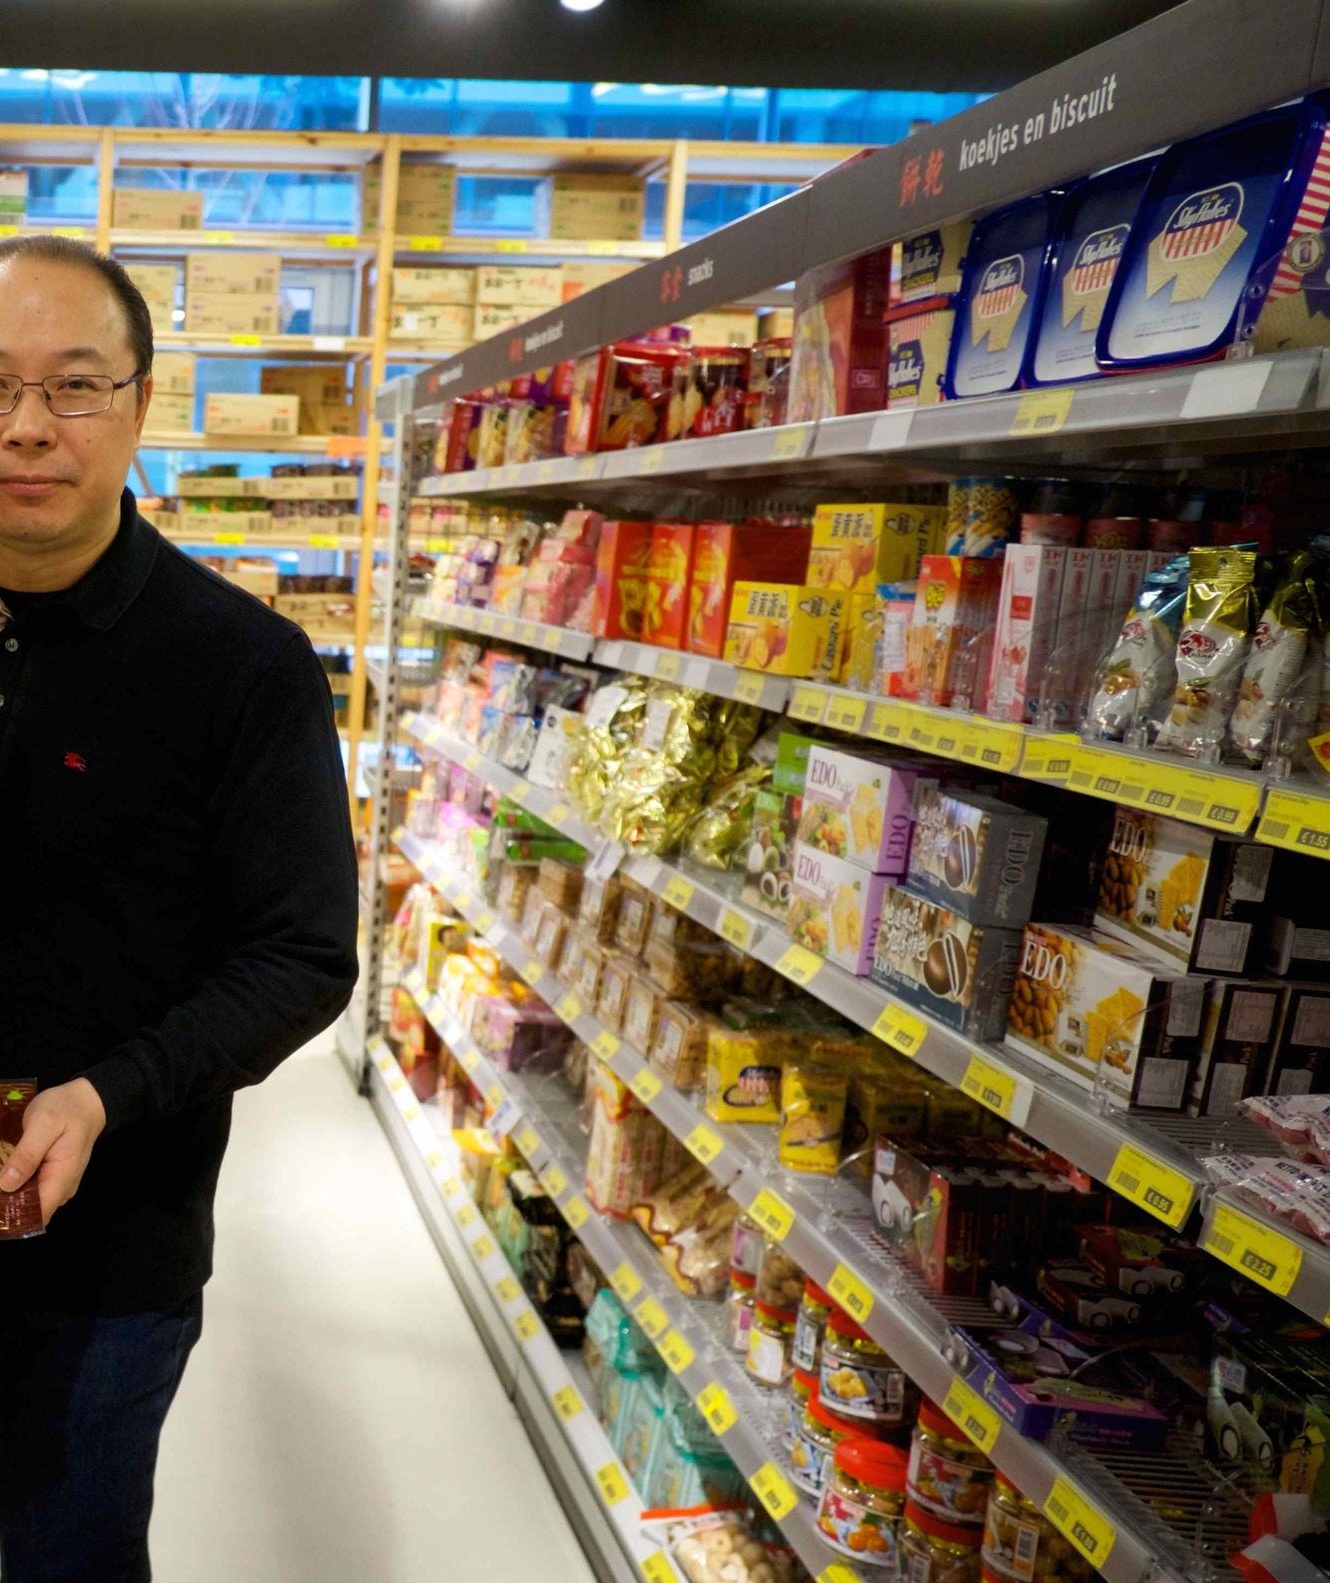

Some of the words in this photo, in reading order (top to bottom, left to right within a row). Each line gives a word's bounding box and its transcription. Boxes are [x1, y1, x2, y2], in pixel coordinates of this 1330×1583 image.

[958, 123, 1019, 171] koekjes
[1023, 113, 1045, 145] en
[1049, 73, 1118, 135] biscuit
[687, 257, 715, 286] snacks
[830, 598, 843, 617] Pie
[822, 619, 840, 671] Custard
[810, 758, 838, 788] EDO
[1208, 806, 1237, 823] €0.99
[886, 814, 909, 862] EDO
[1110, 817, 1148, 863] EDO
[1301, 831, 1329, 848] €1.55
[796, 854, 821, 885] EDO
[1001, 828, 1033, 887] EDO
[1020, 938, 1067, 990] EDO
[1144, 1188, 1171, 1213] €0.95
[1242, 1251, 1274, 1278] €2.25
